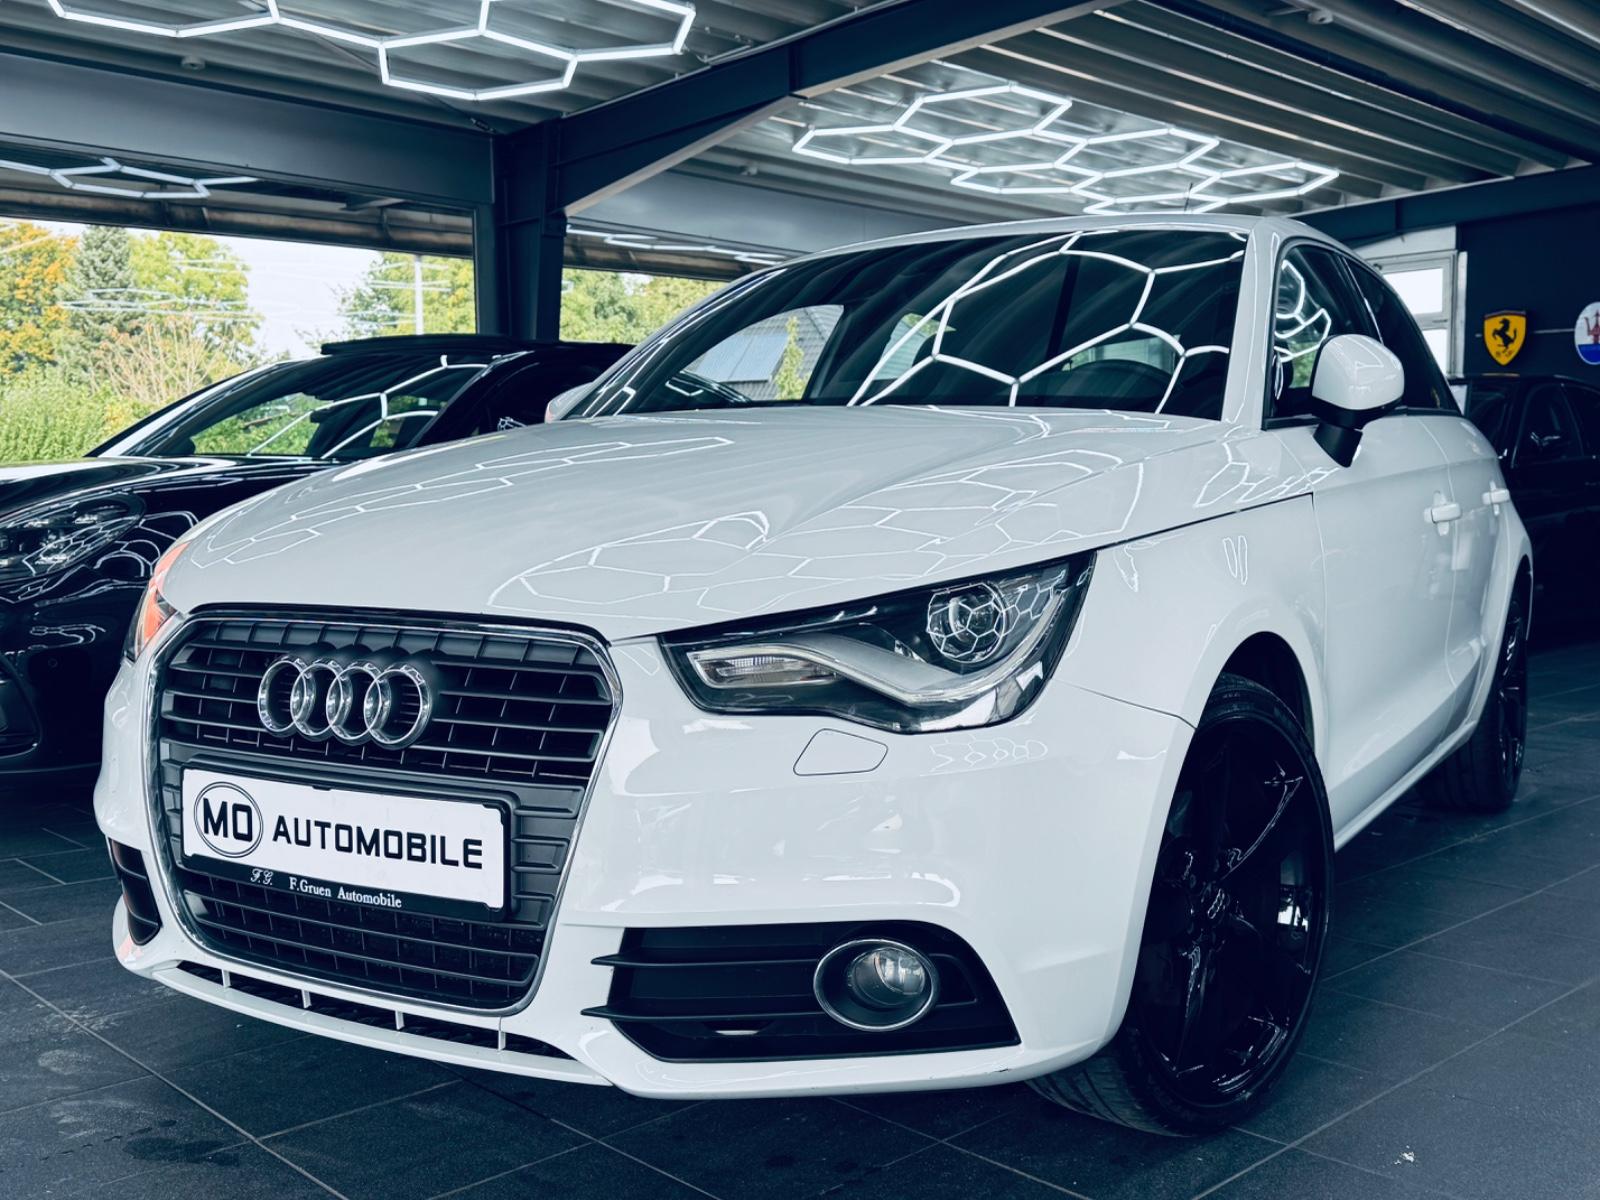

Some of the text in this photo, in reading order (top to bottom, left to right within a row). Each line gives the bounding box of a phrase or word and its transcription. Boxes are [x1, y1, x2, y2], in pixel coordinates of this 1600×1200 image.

[203, 798, 483, 869] MO AUTOMOBILE
[288, 876, 332, 898] F.Gruen
[337, 886, 402, 909] Automobile
